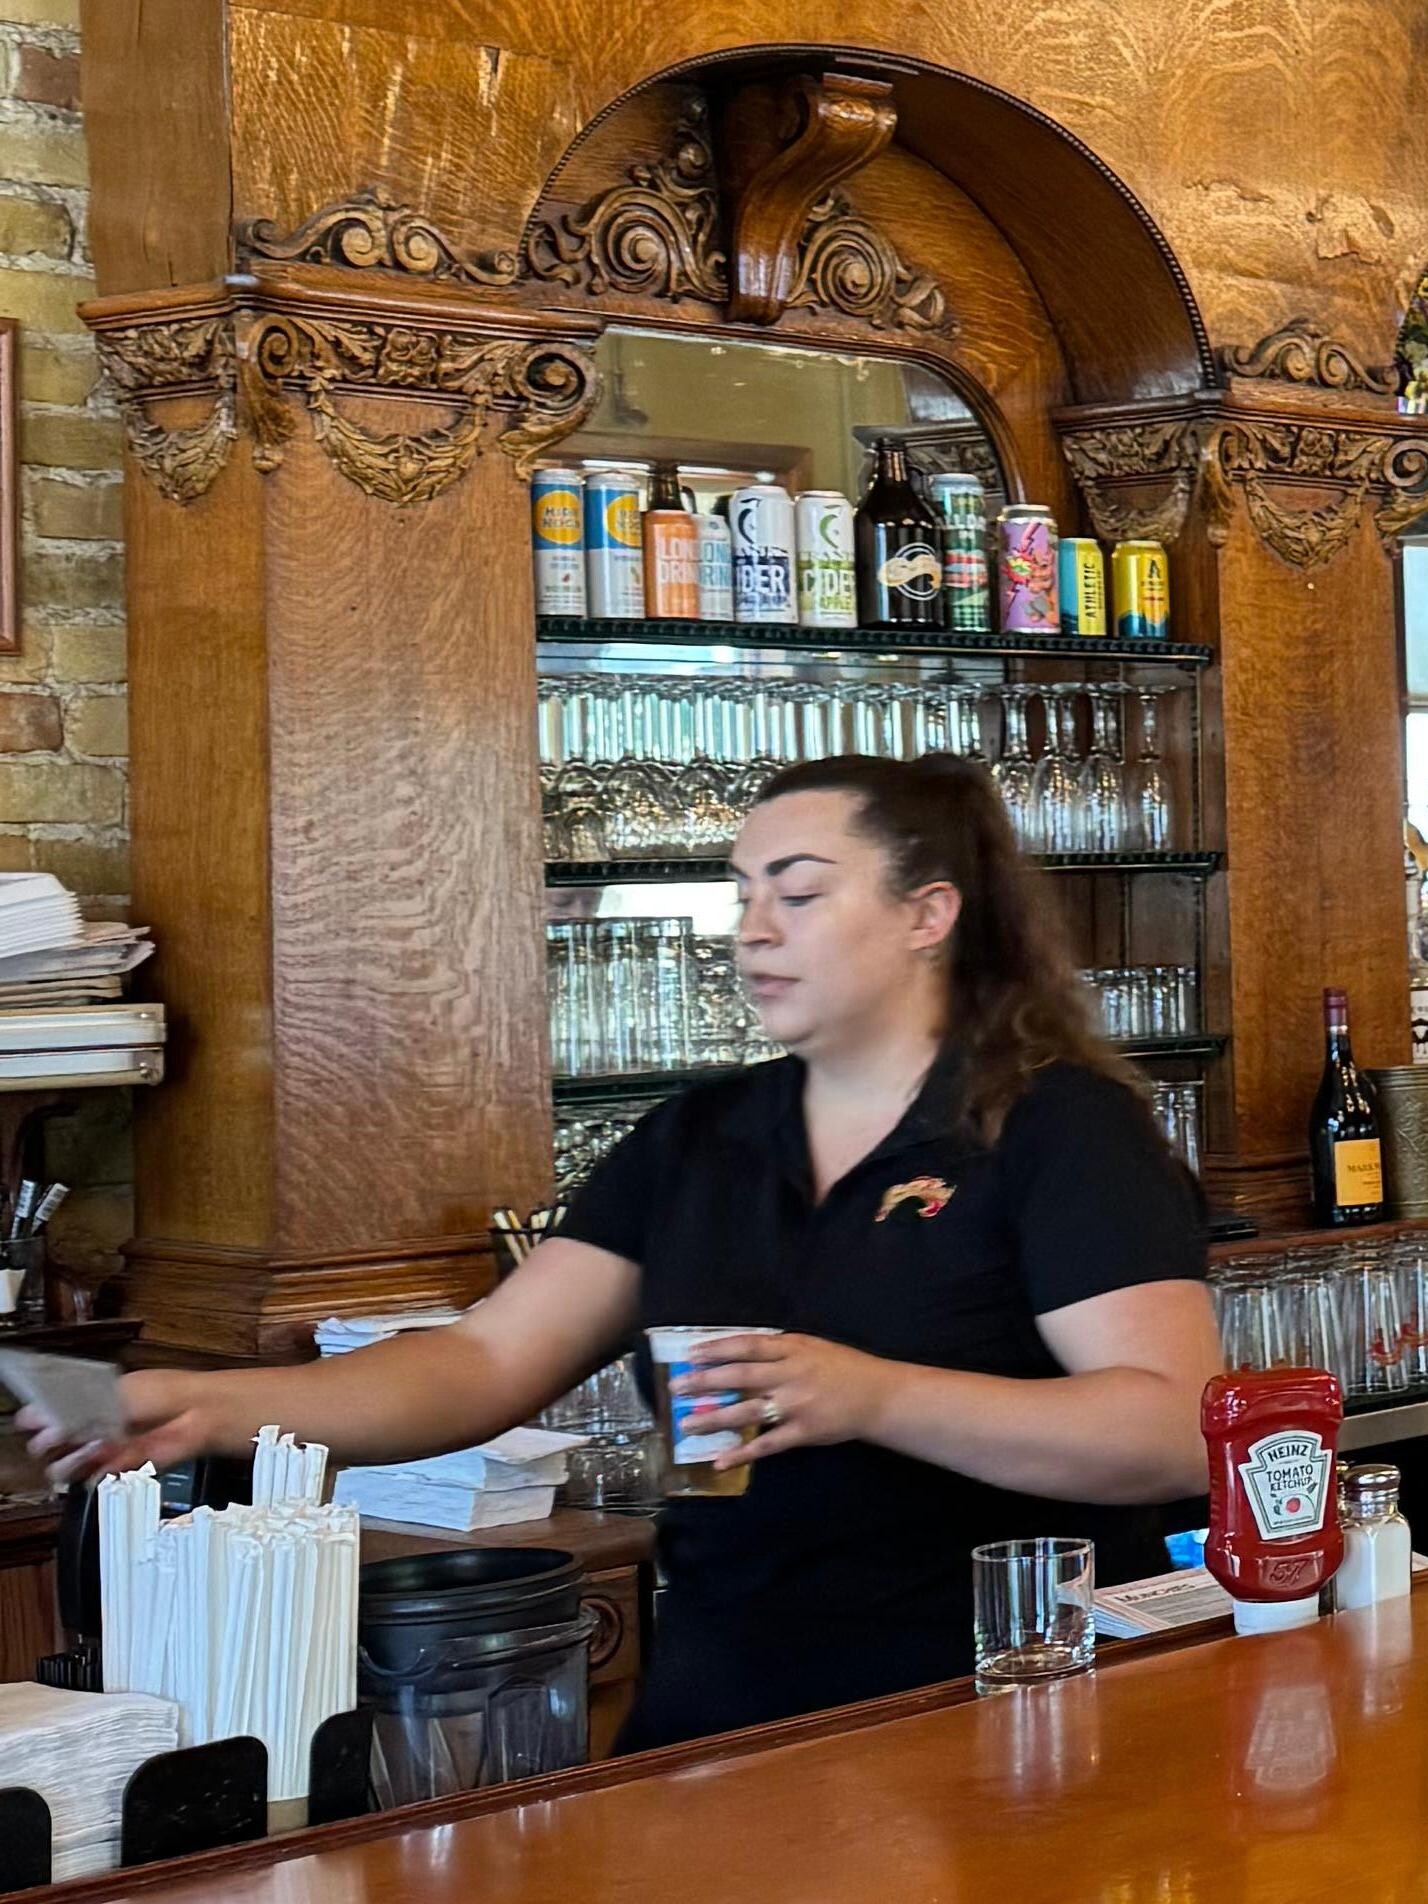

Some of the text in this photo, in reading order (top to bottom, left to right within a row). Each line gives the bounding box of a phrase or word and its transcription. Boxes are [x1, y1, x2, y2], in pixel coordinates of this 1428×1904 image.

[735, 565, 786, 594] IDER
[1084, 563, 1096, 619] ATHLETIC
[1268, 1444, 1309, 1462] HEINZ
[1266, 1463, 1314, 1483] TOMATO
[1270, 1476, 1314, 1492] KETCHUP
[1270, 1557, 1308, 1585] 57
